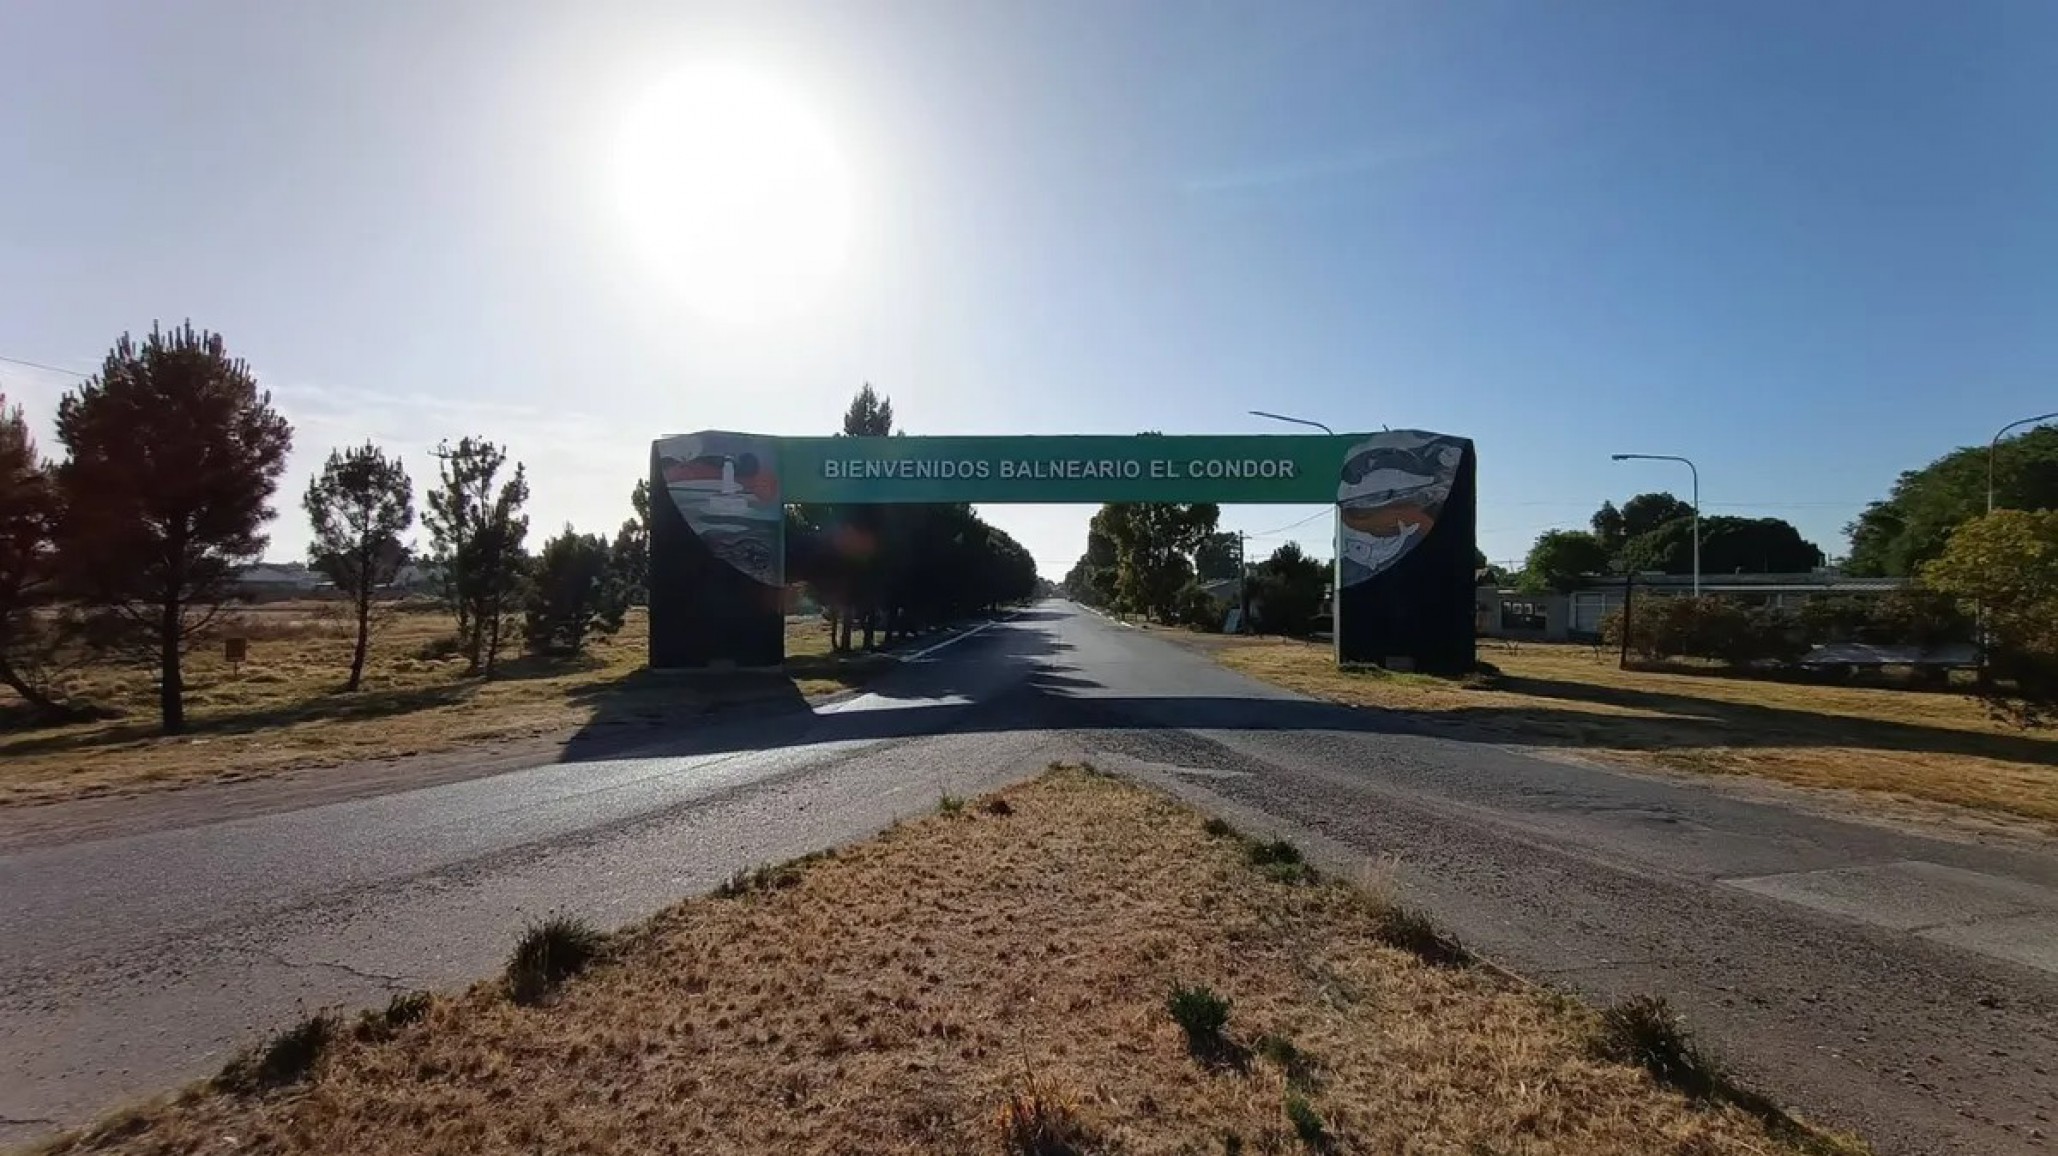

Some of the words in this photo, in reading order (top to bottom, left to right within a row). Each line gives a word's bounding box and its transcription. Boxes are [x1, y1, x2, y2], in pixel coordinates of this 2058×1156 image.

[824, 459, 990, 478] BIENVENIDOS
[999, 459, 1140, 478] BALNEARIO
[1150, 459, 1180, 478] EL
[1189, 459, 1295, 478] CONDOR
